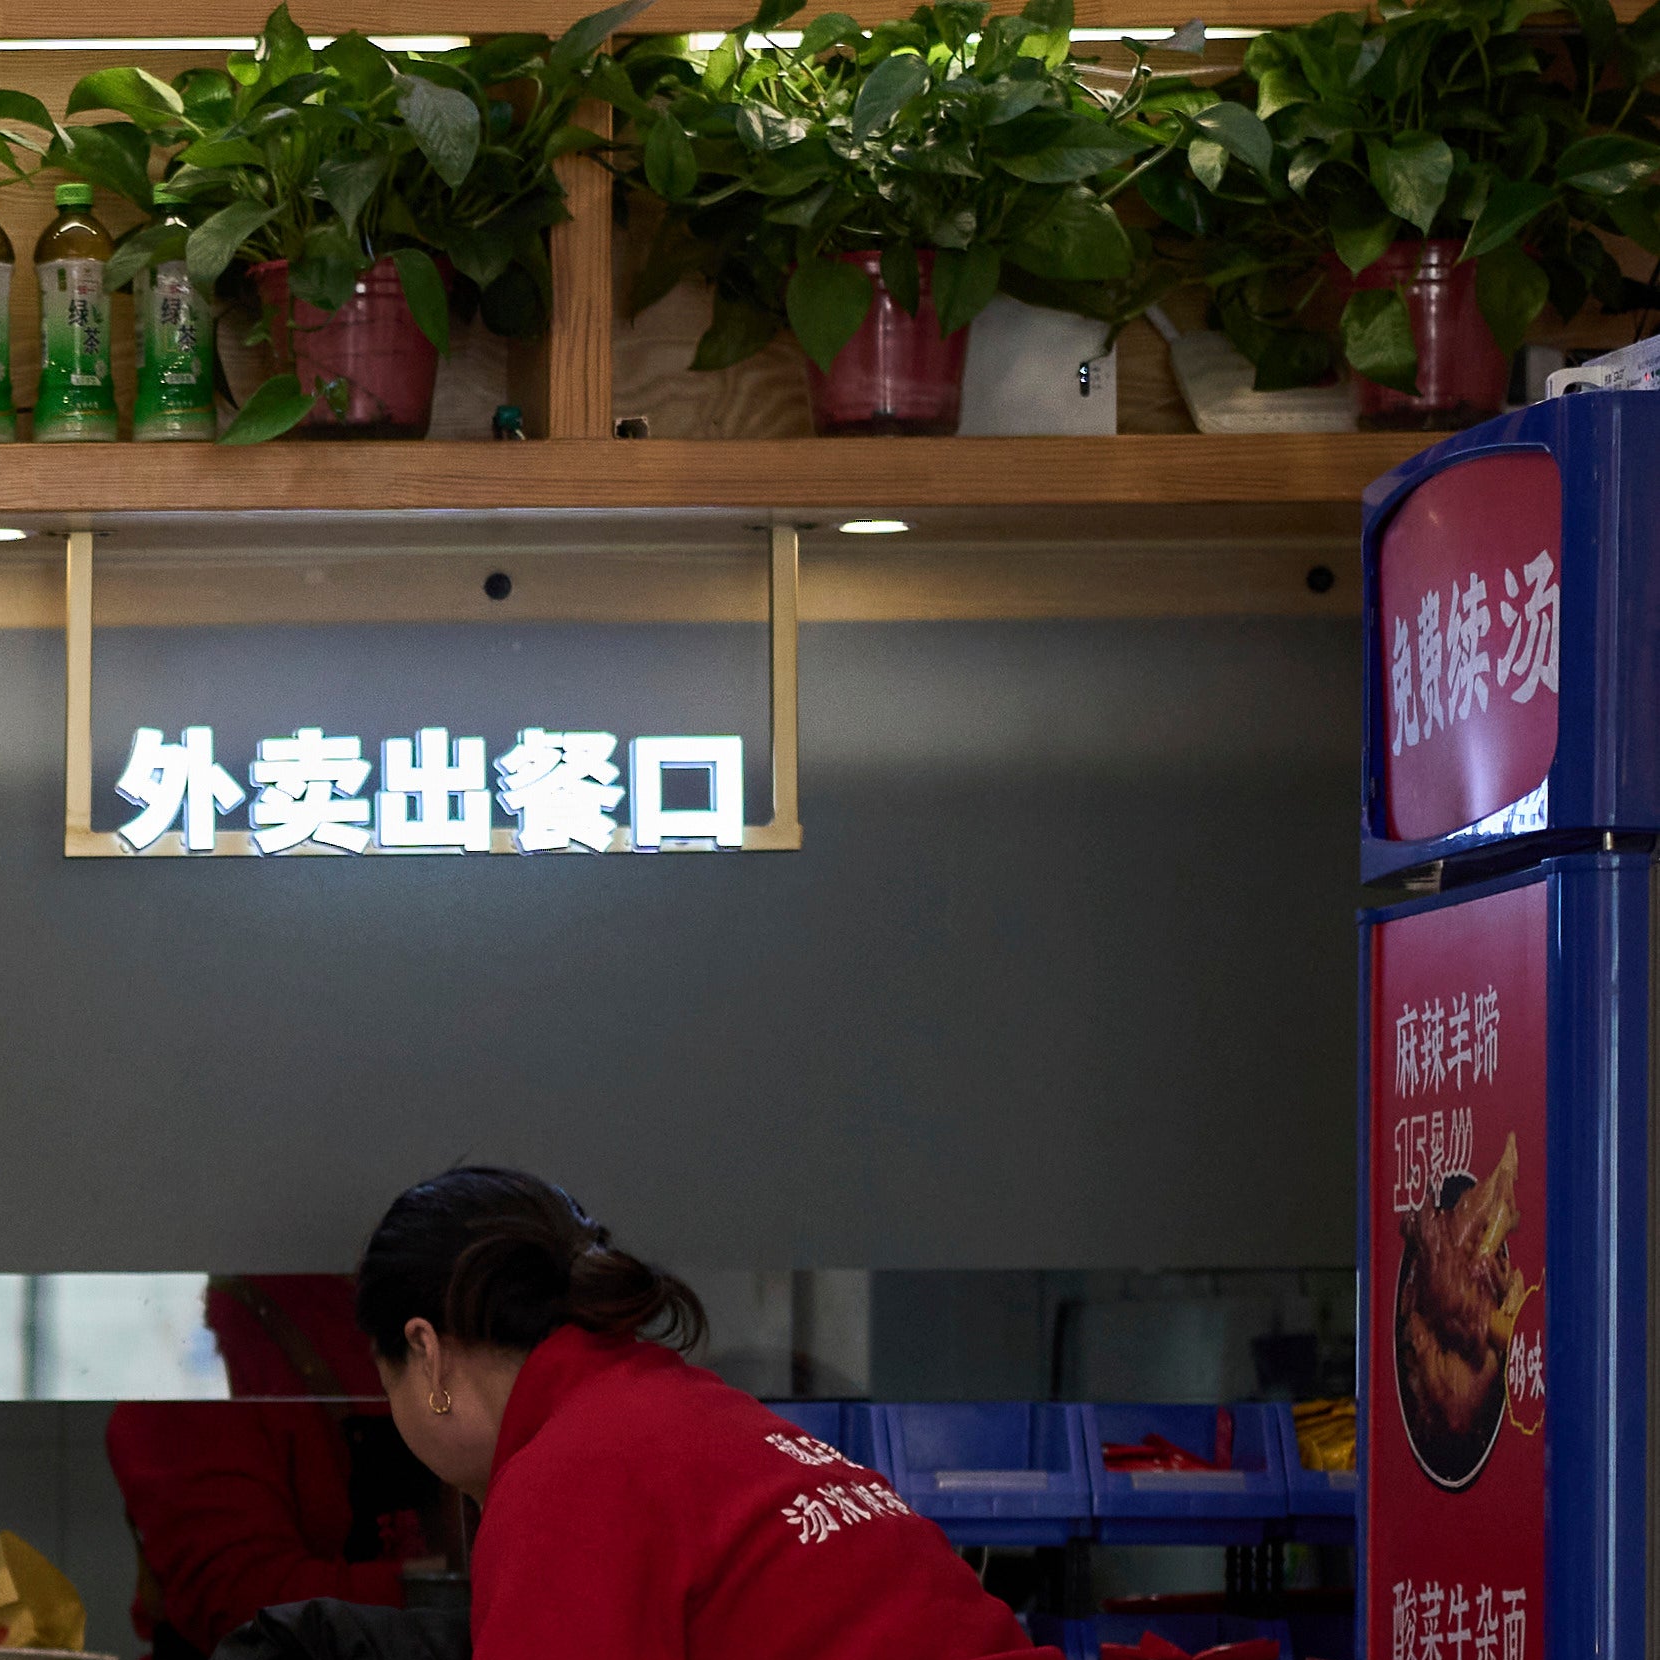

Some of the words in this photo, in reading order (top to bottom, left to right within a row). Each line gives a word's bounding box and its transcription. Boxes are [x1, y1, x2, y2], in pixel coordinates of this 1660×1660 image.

[68, 300, 100, 355] 绿茶
[161, 298, 197, 354] 绿茶
[1390, 549, 1561, 757] 免费续汤
[115, 726, 744, 856] 外卖出餐口
[1394, 984, 1500, 1100] 麻辣羊蹄
[1392, 1114, 1429, 1213] 15
[1507, 1329, 1547, 1404] 够味
